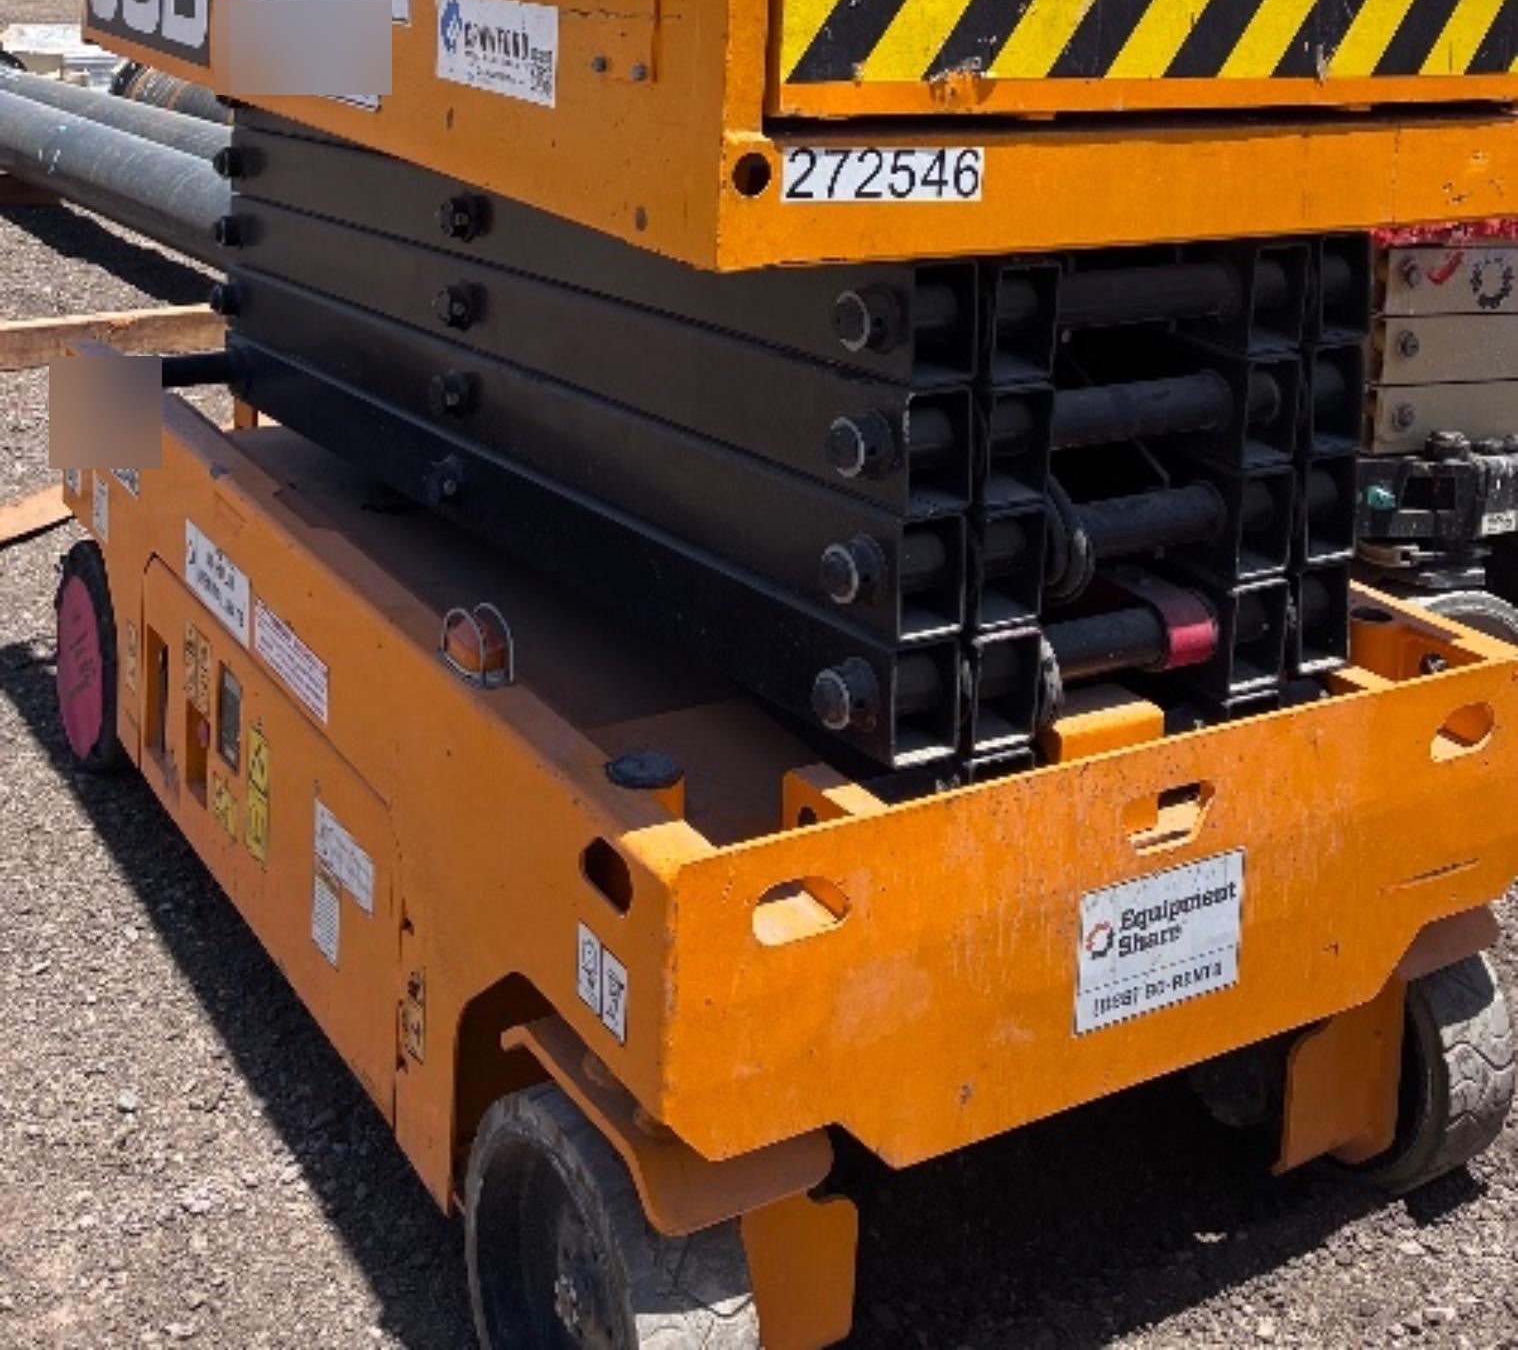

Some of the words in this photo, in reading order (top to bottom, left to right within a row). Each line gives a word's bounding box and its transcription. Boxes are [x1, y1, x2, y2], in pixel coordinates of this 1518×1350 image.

[786, 147, 980, 198] 272546
[1119, 881, 1236, 932] Equipment
[1118, 922, 1183, 958] Share
